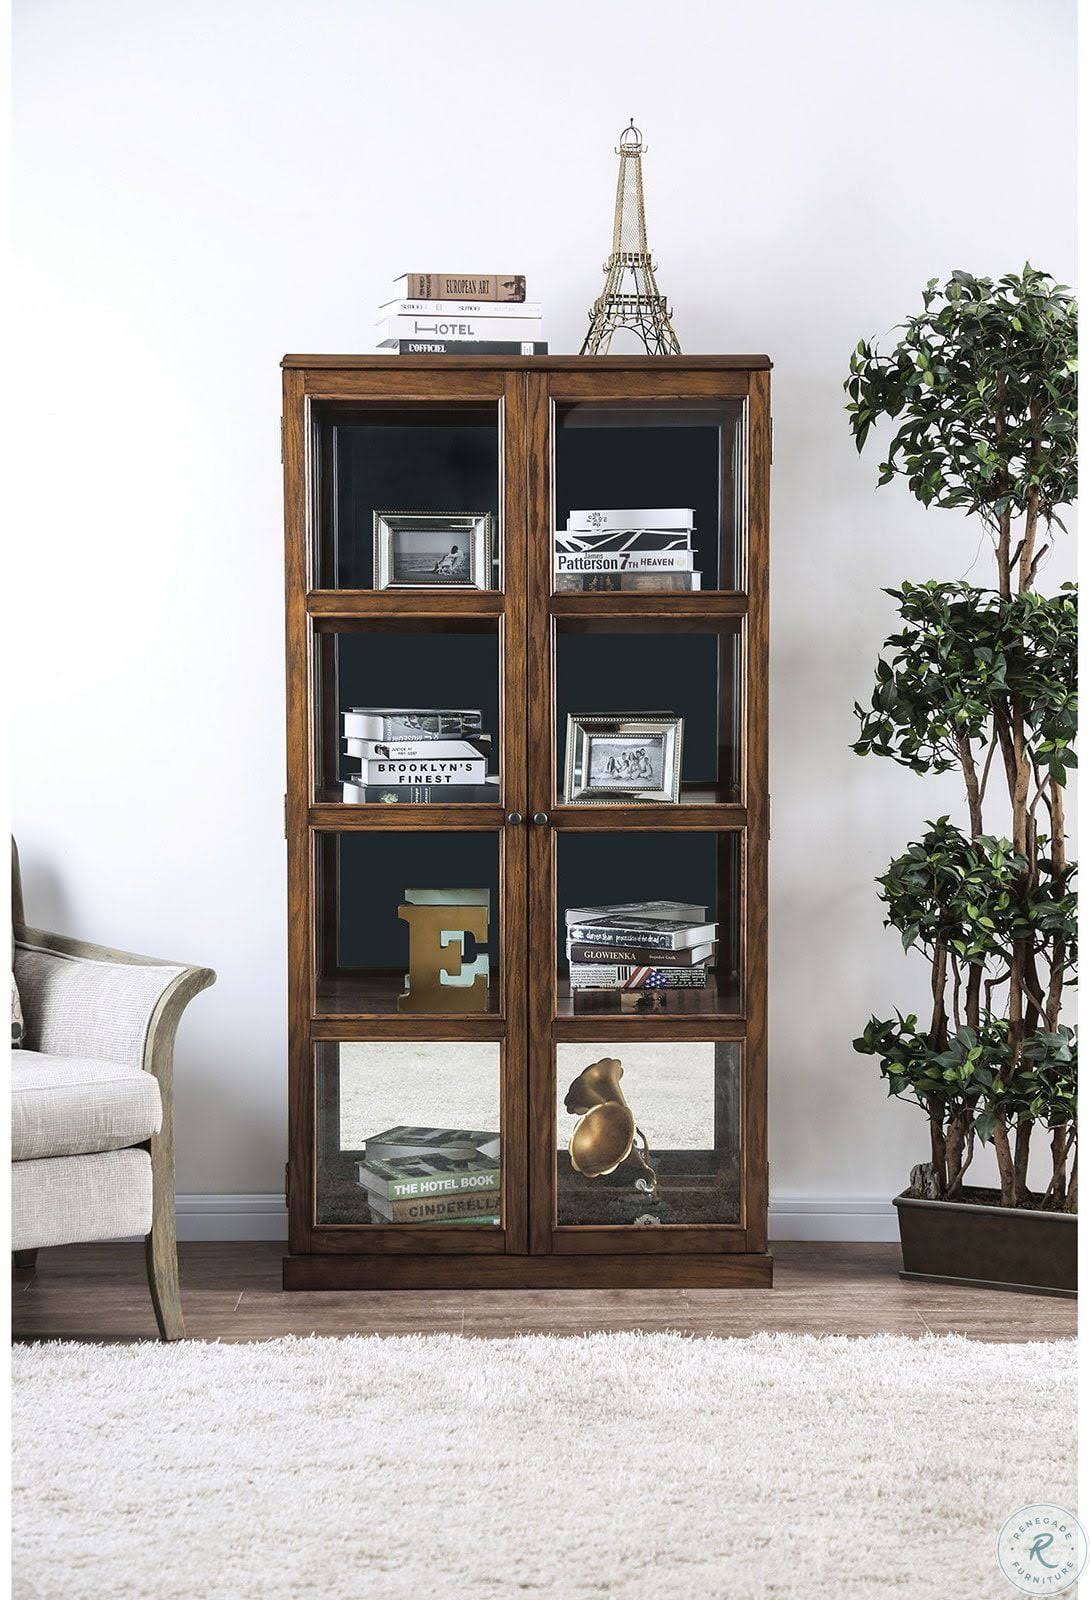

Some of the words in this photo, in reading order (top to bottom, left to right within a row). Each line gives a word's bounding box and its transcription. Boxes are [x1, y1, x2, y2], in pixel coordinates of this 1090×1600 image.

[446, 279, 478, 294] EUROPEAN
[478, 280, 490, 295] ART
[415, 321, 475, 335] HOTEL
[558, 555, 618, 570] Patterson
[640, 558, 674, 567] HEAVEN
[378, 763, 473, 772] BROOKLYN'S
[399, 775, 452, 783] FINEST
[394, 1184, 418, 1196] THE
[420, 1179, 459, 1193] HOTEL
[461, 1174, 495, 1188] BOOK
